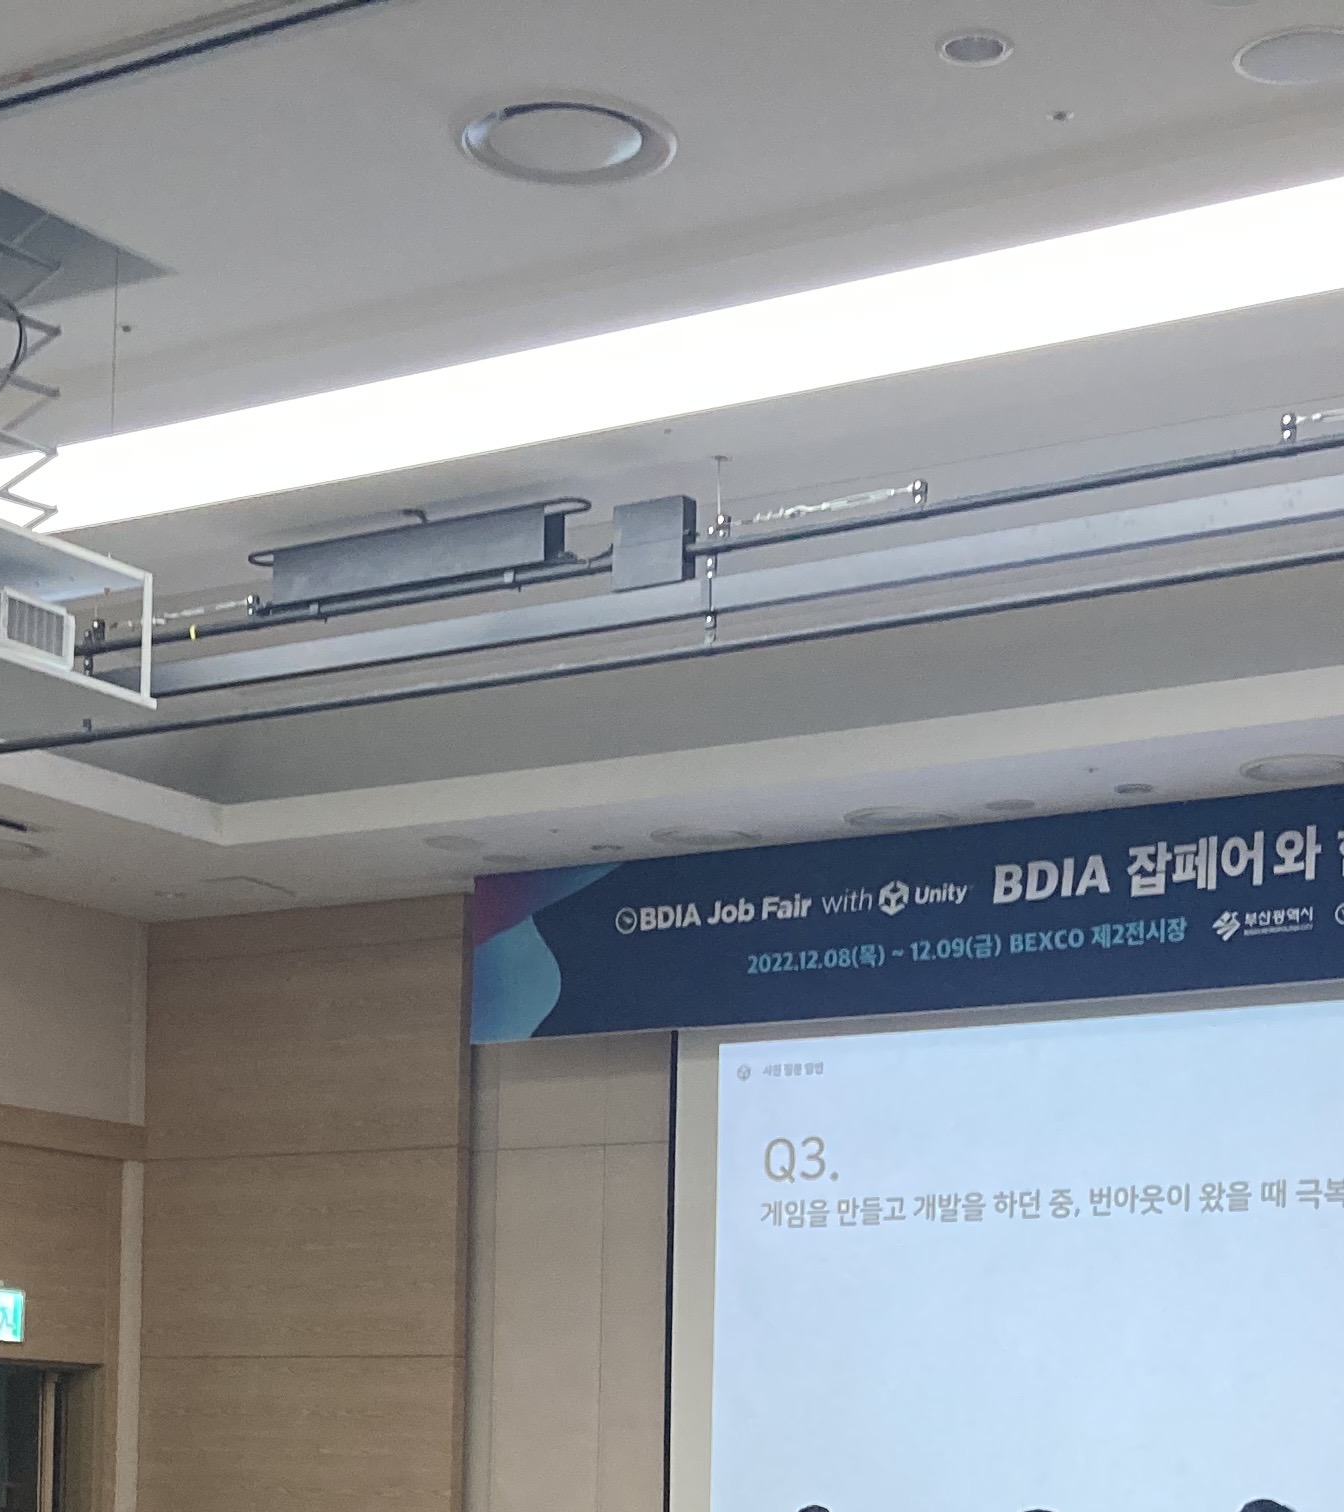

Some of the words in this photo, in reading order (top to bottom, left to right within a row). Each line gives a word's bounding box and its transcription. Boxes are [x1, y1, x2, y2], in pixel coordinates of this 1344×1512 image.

[992, 854, 1111, 904] BDIA
[1127, 824, 1322, 898] 잡페어와
[640, 904, 701, 932] BDIA
[707, 898, 755, 926] Job
[761, 894, 812, 921] Fair
[821, 886, 873, 916] with
[914, 883, 968, 905] Unity
[909, 932, 1002, 962] 12.09(금)
[1010, 929, 1085, 954] BEXCO
[1091, 916, 1188, 949] 제2전시장
[763, 1136, 839, 1184] Q3.
[760, 1198, 830, 1228] 게임을
[836, 1196, 907, 1227] 만들고
[913, 1192, 987, 1223] 개발을
[993, 1188, 1041, 1219] 하던
[1048, 1188, 1080, 1219] 중,
[1089, 1182, 1190, 1217] 번아웃이
[1199, 1180, 1252, 1214] 왔을
[1260, 1178, 1287, 1209] 때
